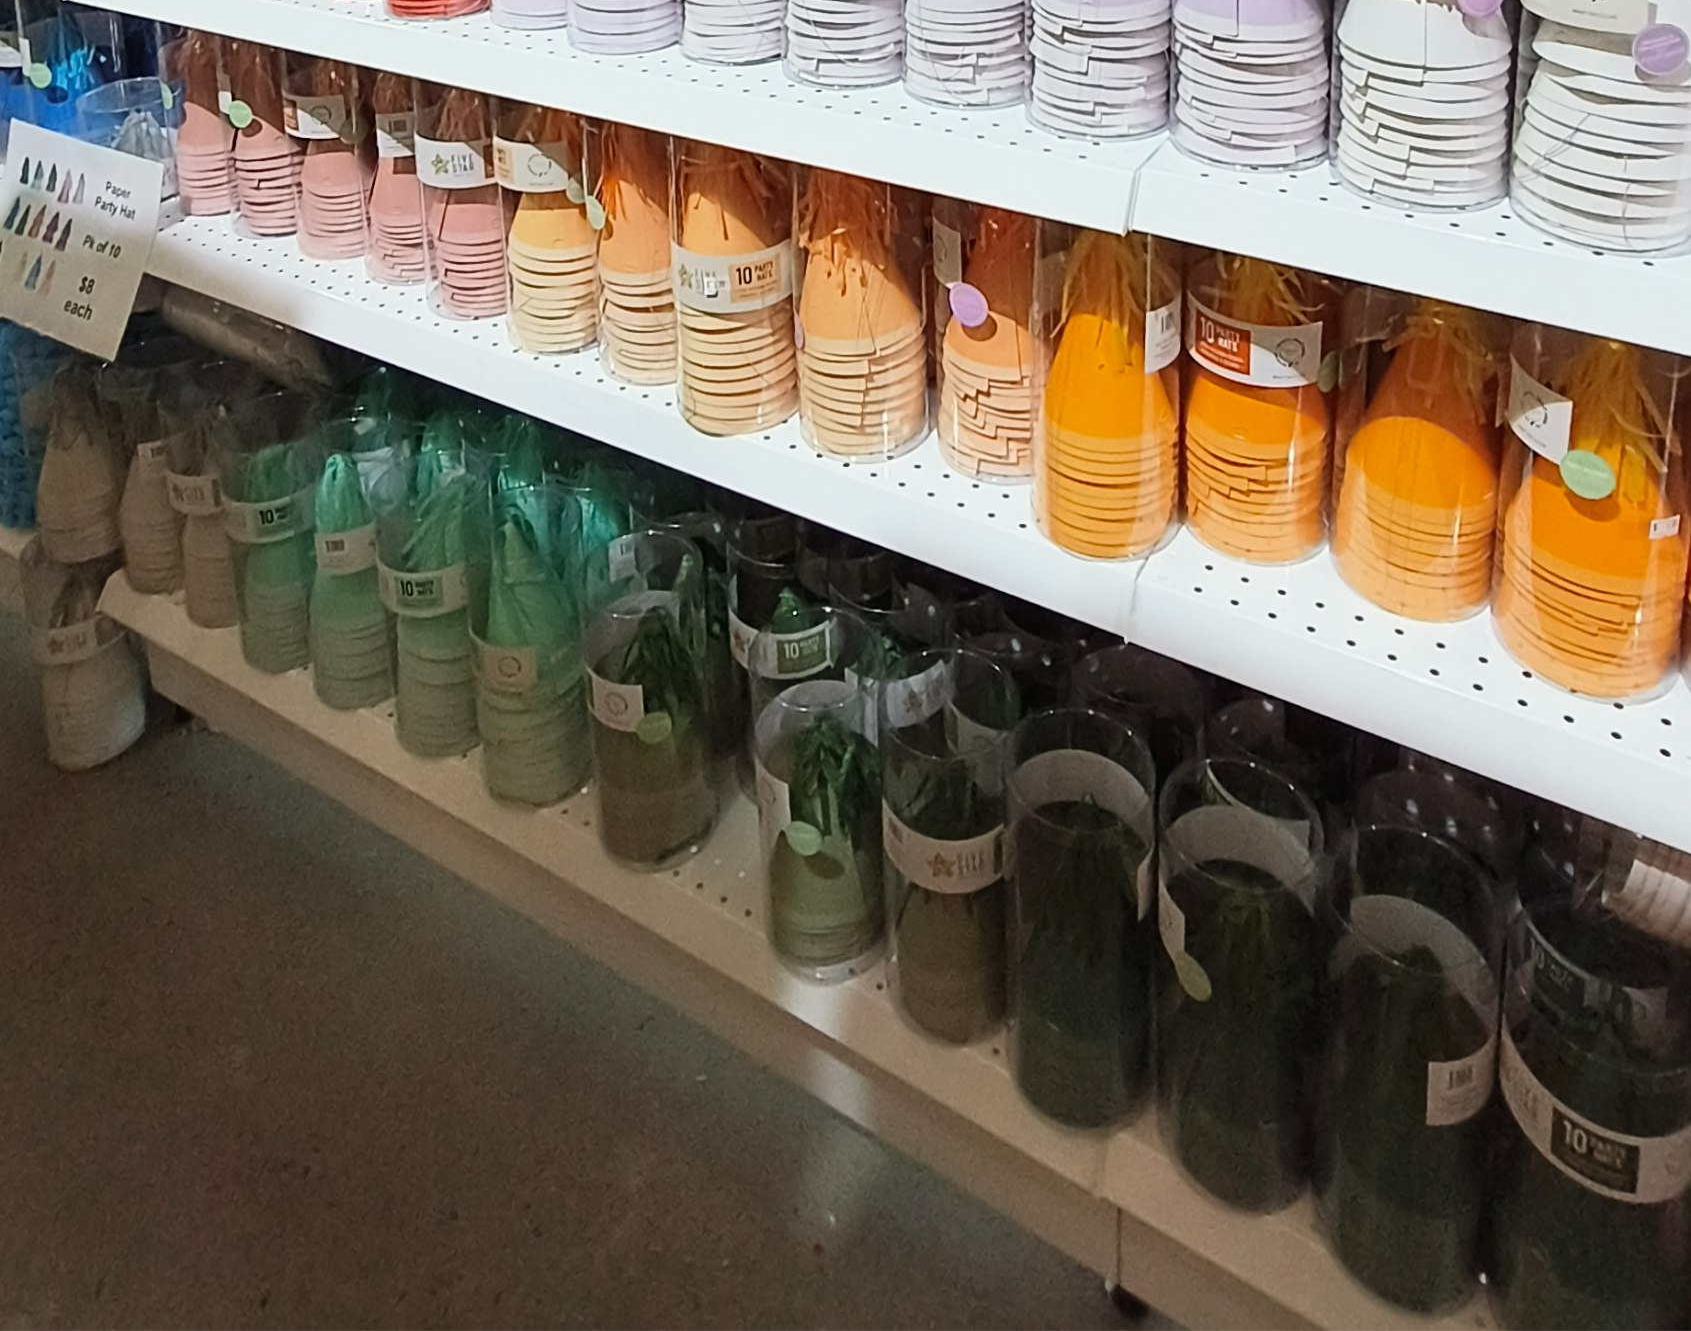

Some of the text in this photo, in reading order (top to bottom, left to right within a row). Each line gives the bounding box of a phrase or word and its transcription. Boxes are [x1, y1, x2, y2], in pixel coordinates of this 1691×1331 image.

[451, 153, 475, 165] FIVE
[105, 181, 132, 199] Paper
[94, 196, 136, 221] Party Hat
[82, 234, 121, 259] Pk of 10
[735, 266, 753, 286] 10
[754, 260, 774, 273] PARTY
[79, 275, 95, 296] $8
[63, 299, 93, 322] each
[1200, 316, 1215, 344] 10
[1218, 337, 1239, 353] HATS
[259, 509, 274, 526] 10
[400, 579, 414, 597] 10
[783, 641, 800, 660] 10
[1563, 1119, 1588, 1155] 10
